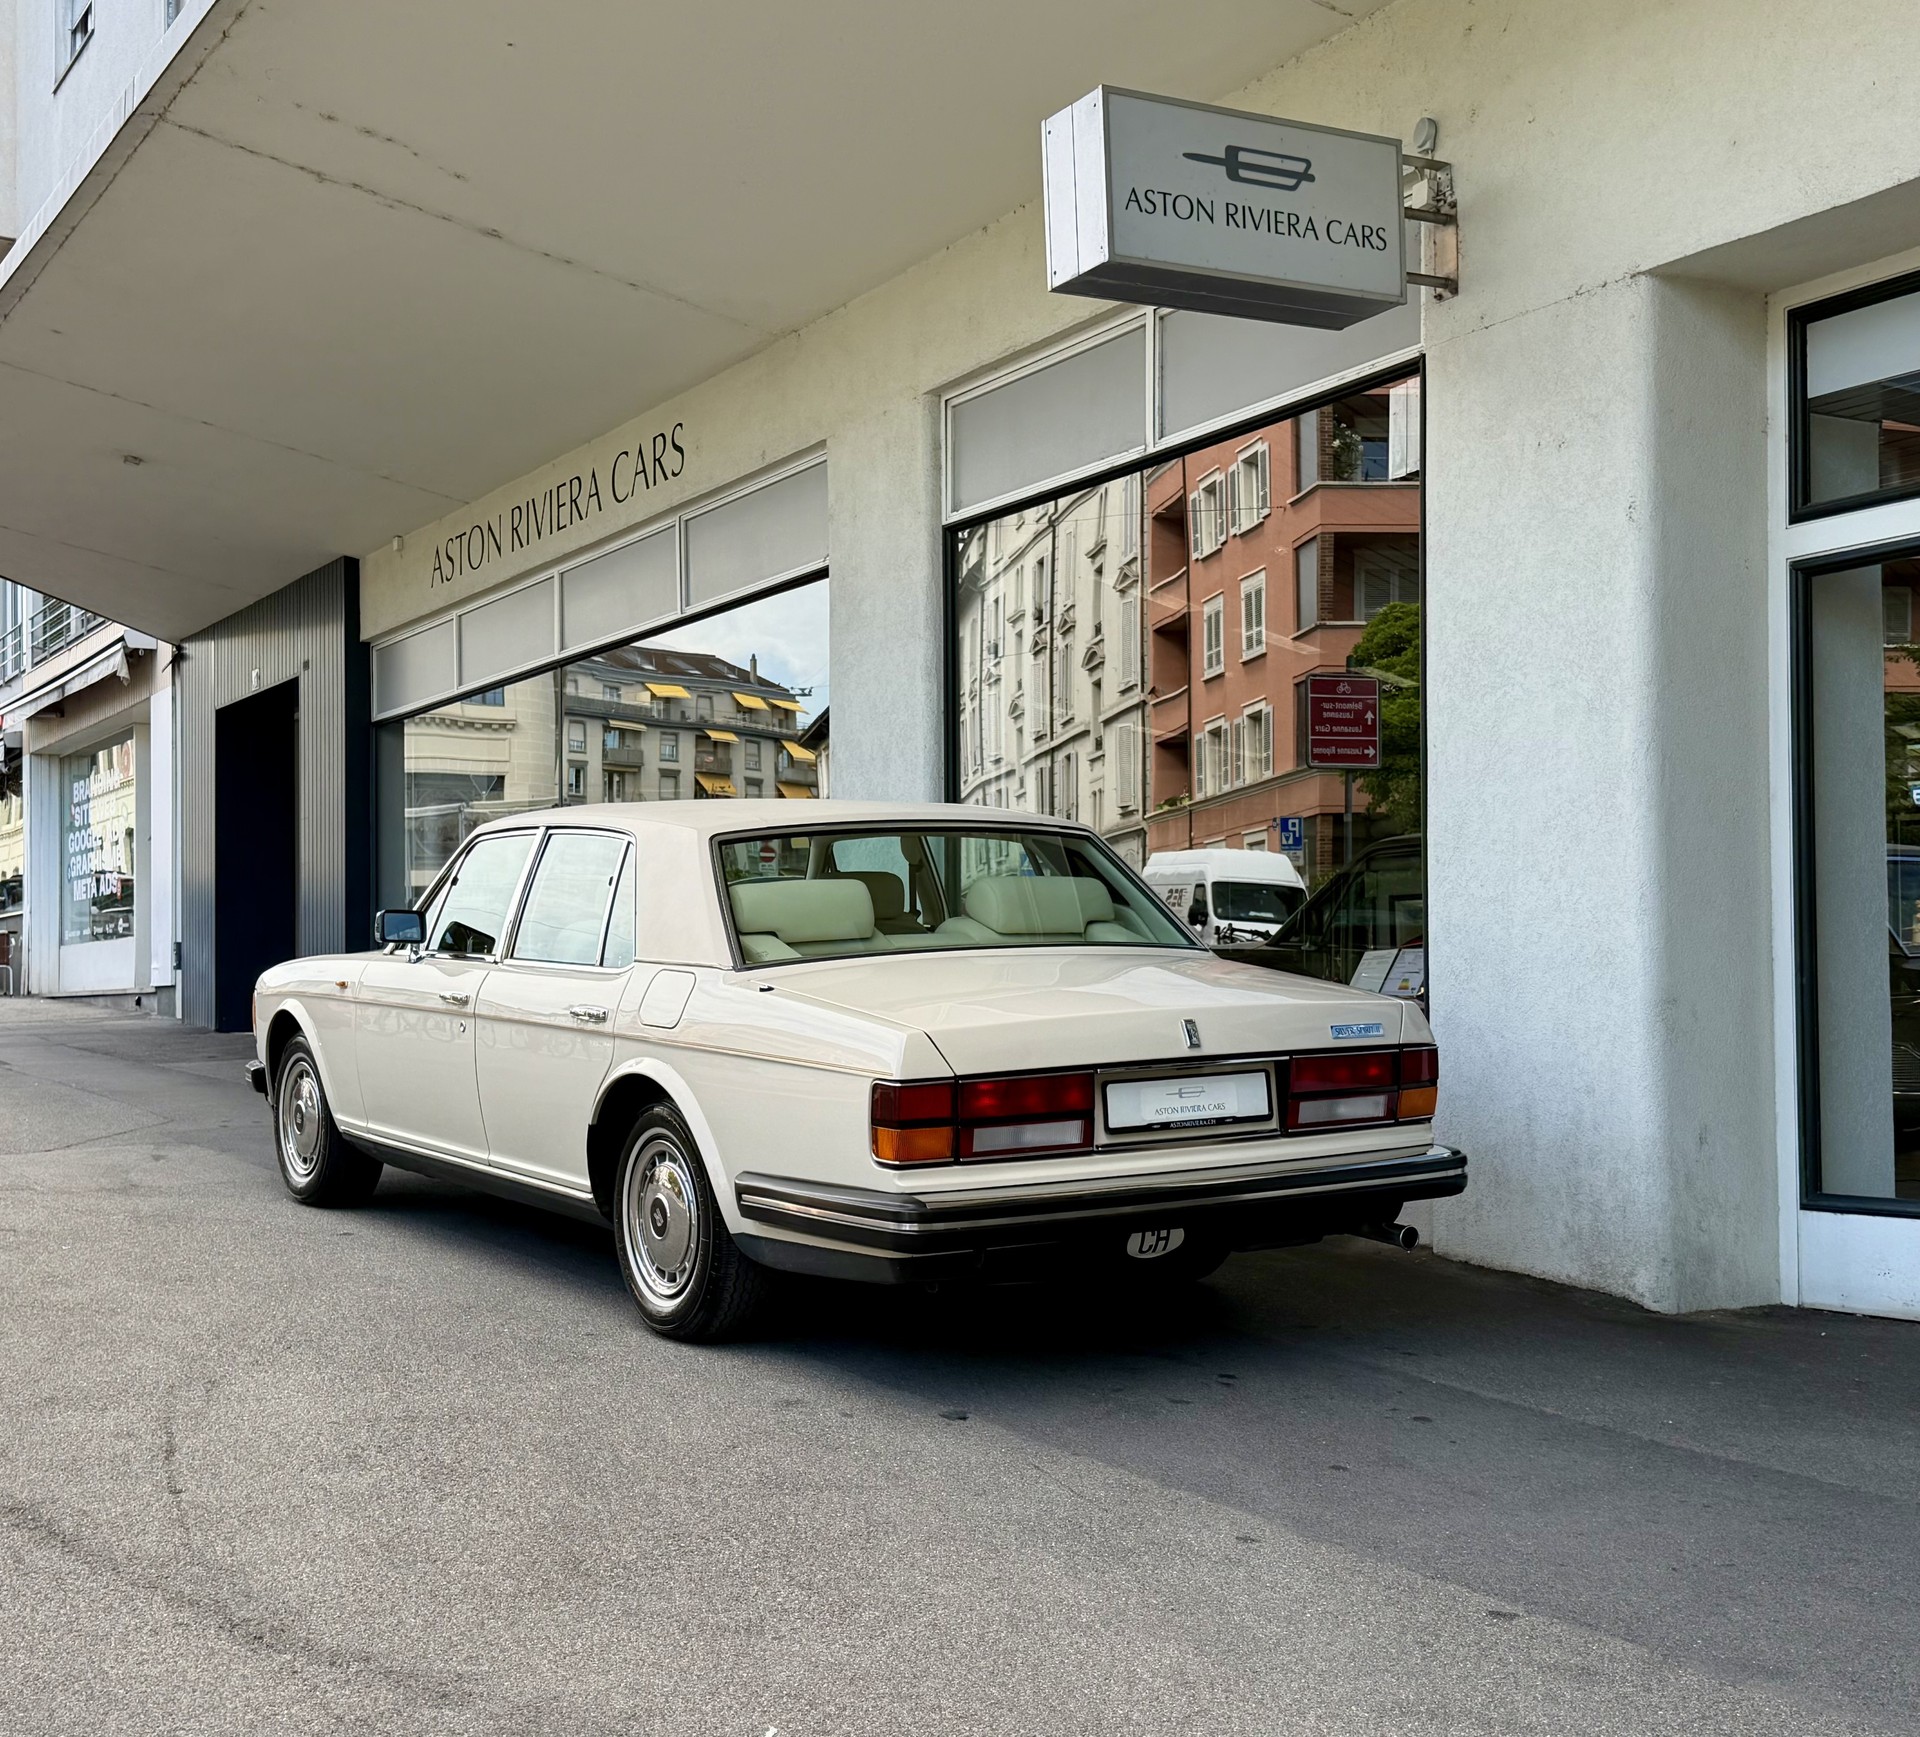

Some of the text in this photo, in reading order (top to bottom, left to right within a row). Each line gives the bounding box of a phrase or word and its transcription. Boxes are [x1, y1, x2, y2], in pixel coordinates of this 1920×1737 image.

[1125, 187, 1387, 251] ASTON RIVIERA CARS
[431, 422, 685, 588] ASTON RIVIERA CARS
[73, 871, 118, 901] META ADS
[1154, 1102, 1226, 1115] ASTON RIVIERA CARS
